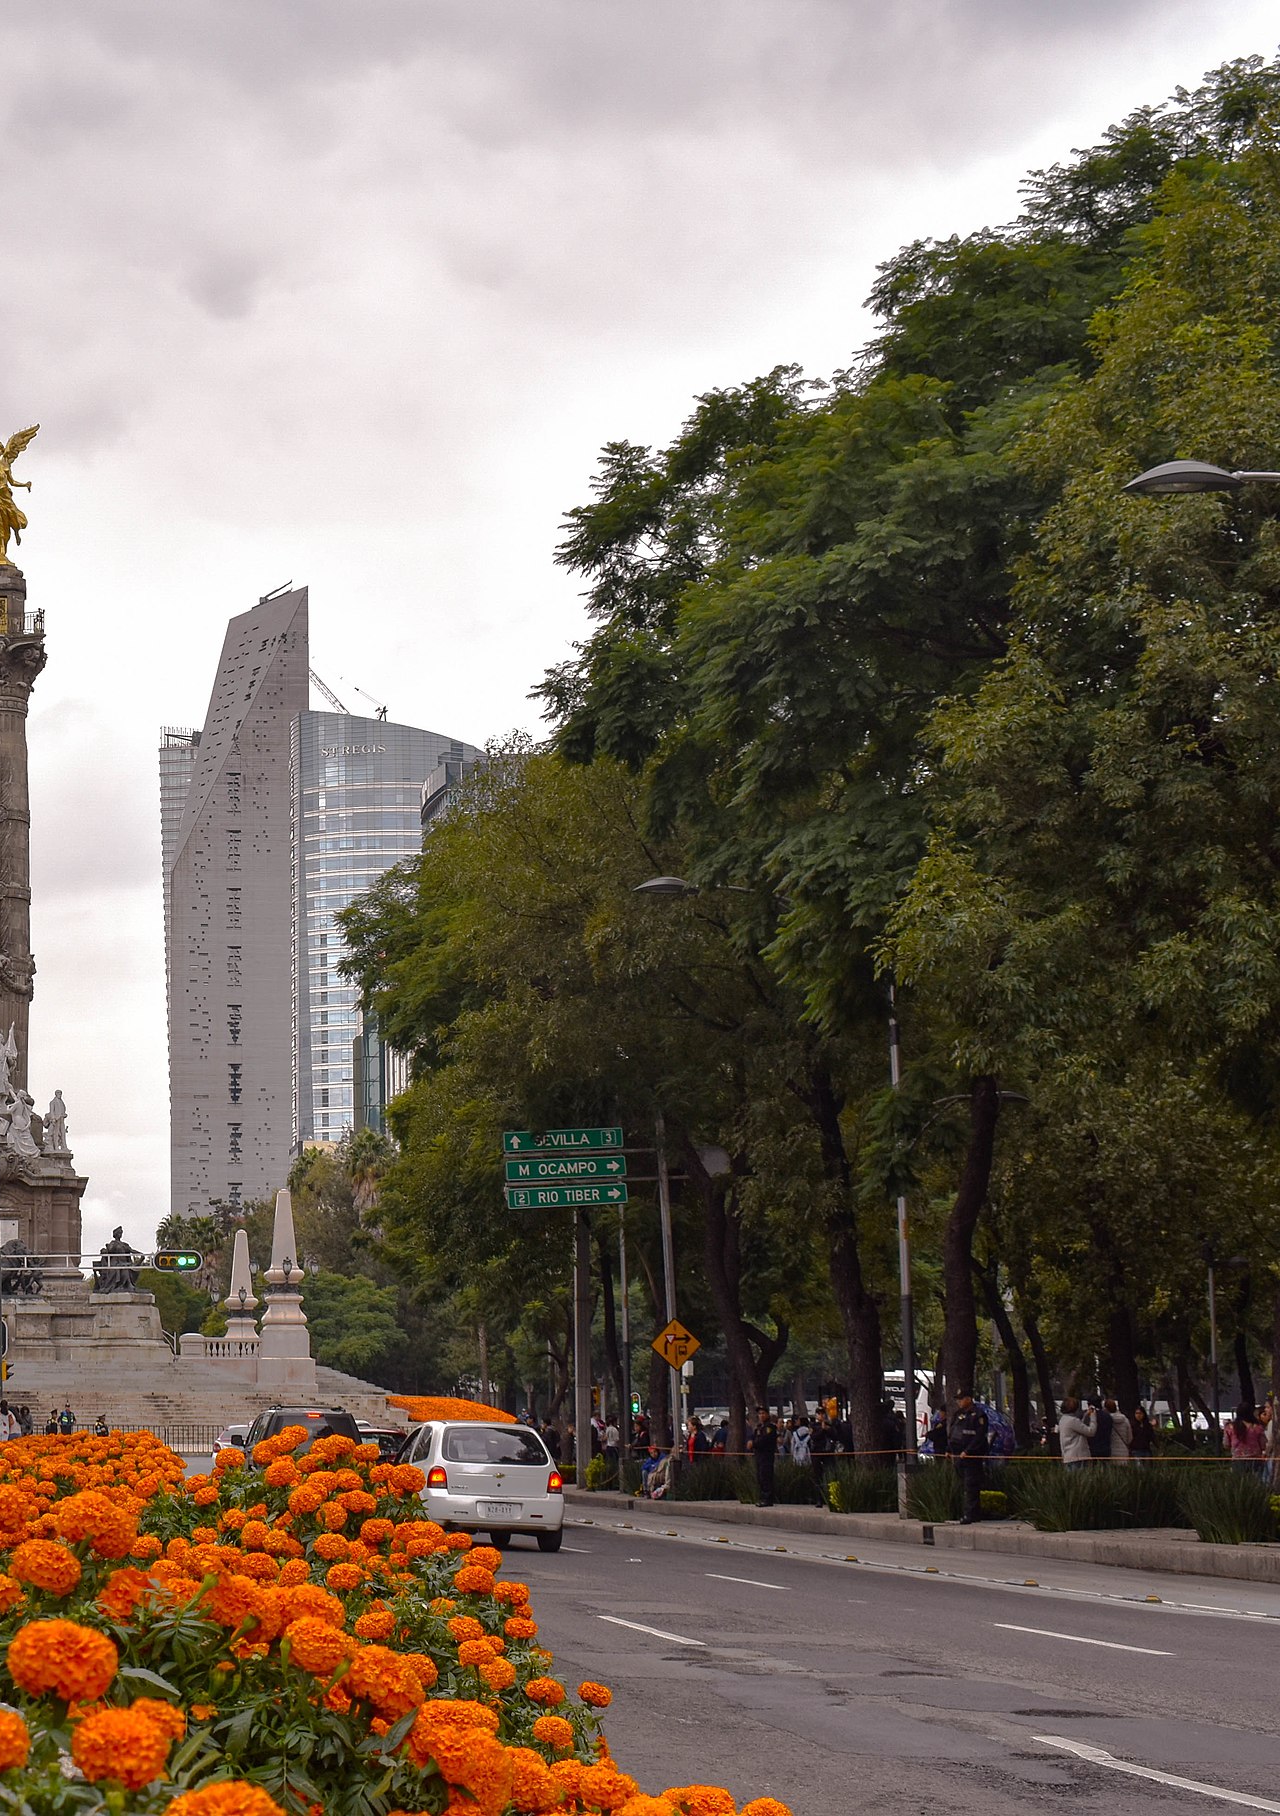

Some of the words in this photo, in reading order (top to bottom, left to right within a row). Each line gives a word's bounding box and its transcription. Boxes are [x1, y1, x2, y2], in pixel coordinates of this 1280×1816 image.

[341, 744, 387, 755] REGIS
[606, 1133, 612, 1142] 3
[519, 1164, 530, 1176] M
[538, 1161, 597, 1175] OCAMPO
[519, 1195, 526, 1203] 2
[538, 1191, 559, 1203] RIO
[564, 1189, 600, 1201] TIBER
